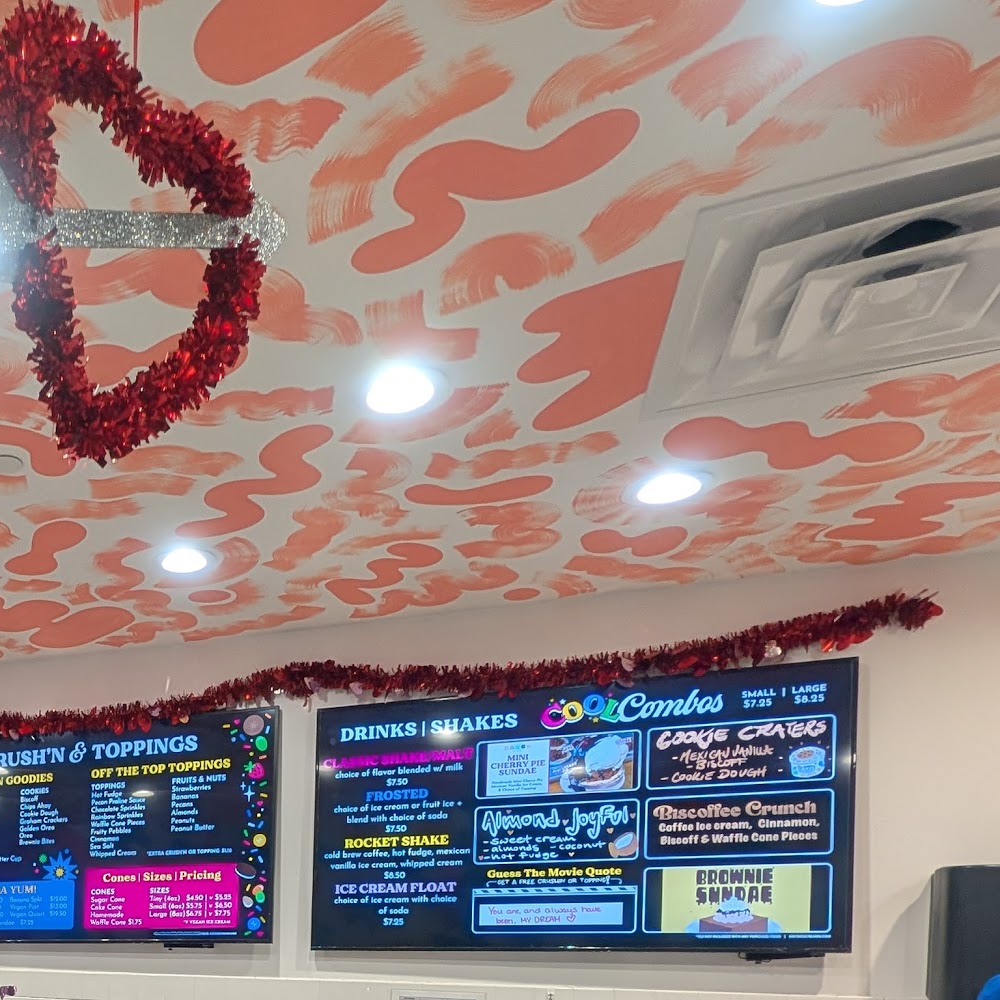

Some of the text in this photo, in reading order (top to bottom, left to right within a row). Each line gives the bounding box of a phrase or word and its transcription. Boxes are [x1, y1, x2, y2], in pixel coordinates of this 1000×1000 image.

[742, 684, 827, 699] SMALL LARGE
[617, 688, 724, 722] Combos
[743, 694, 825, 708] $7.25 $8.25
[340, 713, 518, 742] DRINKS SHAKES
[656, 720, 827, 750] COOKIE CRATERS
[69, 741, 87, 763] &
[91, 735, 198, 759] TOPPINGS
[507, 754, 529, 762] MINI
[91, 758, 231, 779] OFF THE TOP TOPPINGS
[491, 759, 546, 770] CHERRY PIE
[335, 763, 463, 779] choice of flavor blended w/ milk
[498, 767, 536, 776] SUNDAE
[671, 766, 767, 783] COOKIE DOUGH
[6, 773, 53, 785] GOODIES
[171, 776, 197, 784] FRUITS
[206, 774, 227, 782] NUTS
[386, 778, 408, 787] $7.50
[20, 787, 49, 795] COOKIES
[91, 782, 125, 791] TOPPINGS
[366, 788, 429, 802] FROSTED
[334, 804, 358, 813] choice
[360, 803, 369, 811] of
[371, 803, 382, 811] ice
[384, 803, 409, 811] cream
[422, 800, 440, 809] fruit
[653, 800, 817, 820] Biscoffee Crunch
[347, 811, 448, 824] blend with choice of soda
[481, 808, 560, 837] Almond
[385, 825, 407, 833] $7.50
[658, 822, 693, 832] Coffee
[344, 835, 449, 849] ROCKET SHAKE
[490, 835, 576, 845] sweet cream
[660, 831, 818, 845] Biscoff & Waffle Cone Pieces
[491, 841, 606, 852] almonds coconut
[324, 851, 340, 859] cold
[342, 850, 361, 858] brew
[491, 852, 559, 860] hot fudge
[330, 861, 356, 870] vanilla
[358, 860, 369, 869] ice
[400, 859, 435, 868] whipped
[103, 871, 221, 883] Cones Sizes Pricing
[384, 871, 406, 879] $8.50
[487, 867, 622, 878] Guess The Movie Quote
[696, 868, 774, 885] BROWNIE
[10, 885, 37, 894] YUM!
[335, 882, 457, 895] ICE CREAM FLOAT
[696, 886, 772, 905] SUNDAE
[488, 906, 503, 914] You
[524, 906, 541, 914] and
[544, 906, 578, 917] always
[383, 918, 404, 926] $7.25
